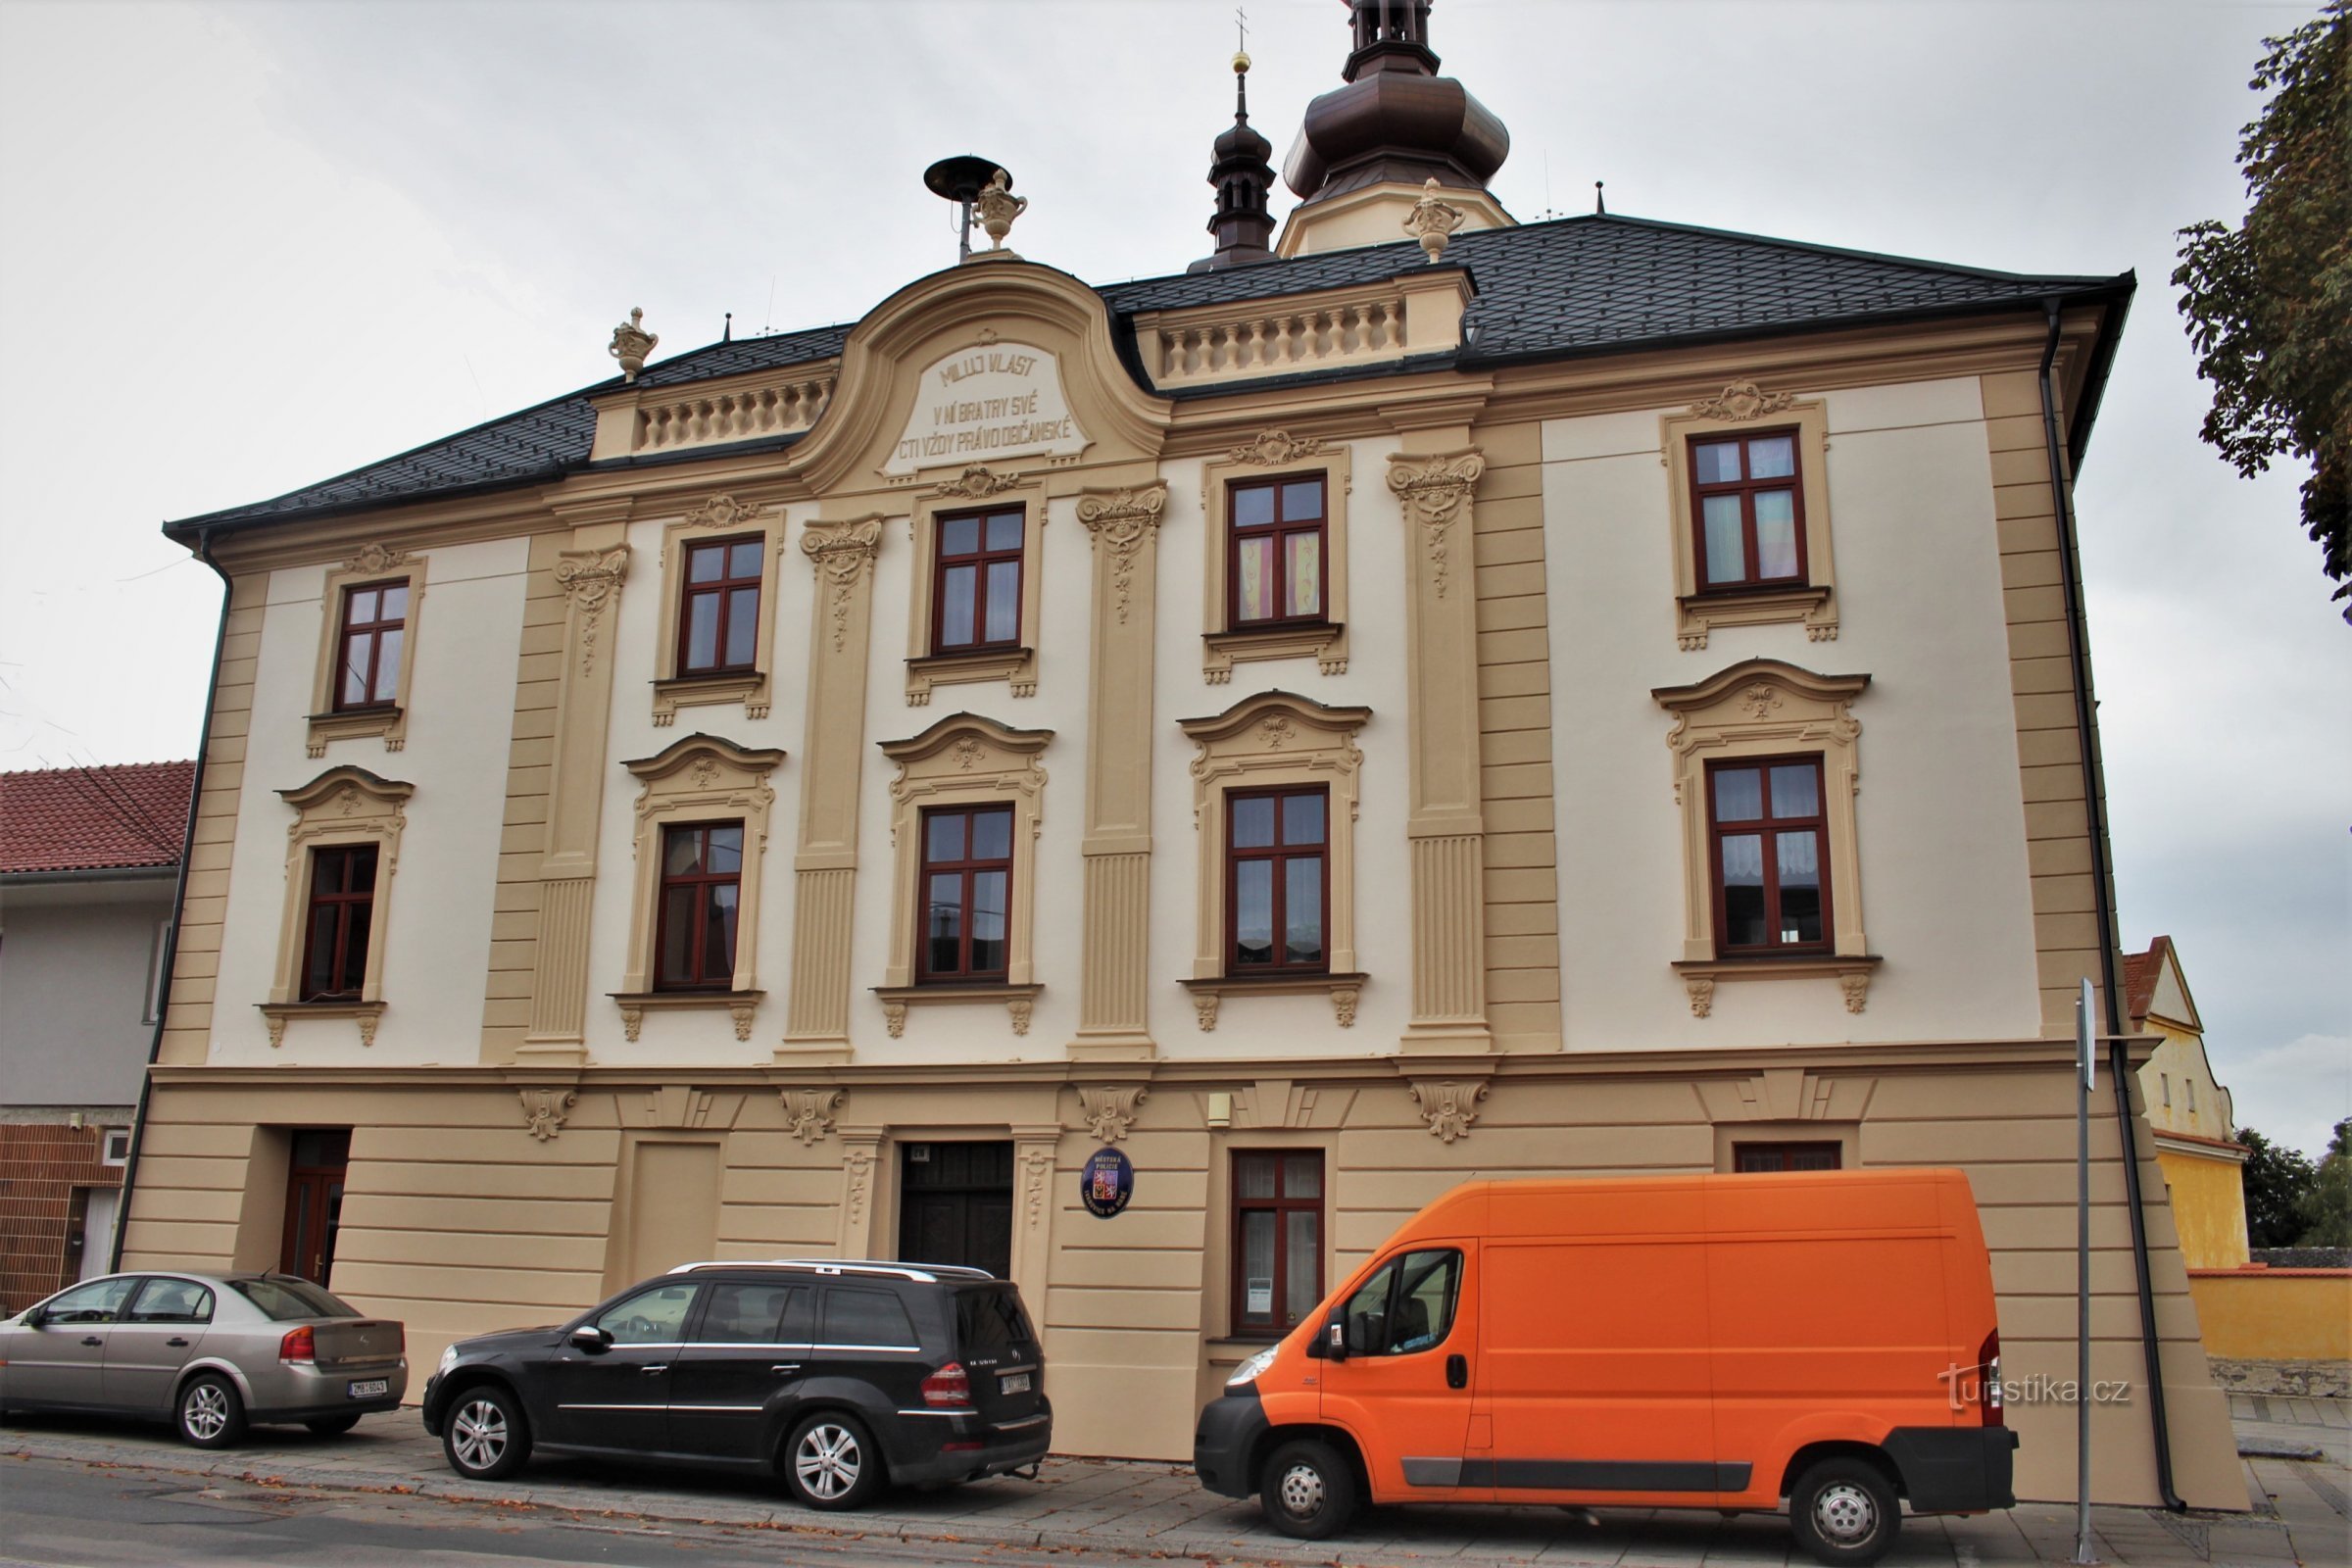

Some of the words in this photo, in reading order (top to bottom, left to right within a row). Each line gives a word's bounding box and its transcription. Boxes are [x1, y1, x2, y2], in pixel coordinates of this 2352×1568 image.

[939, 355, 985, 388] MILUJ
[989, 353, 1038, 377] VLAST
[934, 407, 942, 425] V
[944, 400, 957, 424] NÍ
[959, 397, 1008, 423] BRATRY
[1011, 389, 1039, 416] SVÉ
[899, 439, 919, 460] CTI
[922, 431, 956, 457] VŽDY
[956, 425, 1001, 452] PRÁVO
[1002, 415, 1072, 448] OBČANSKÉ
